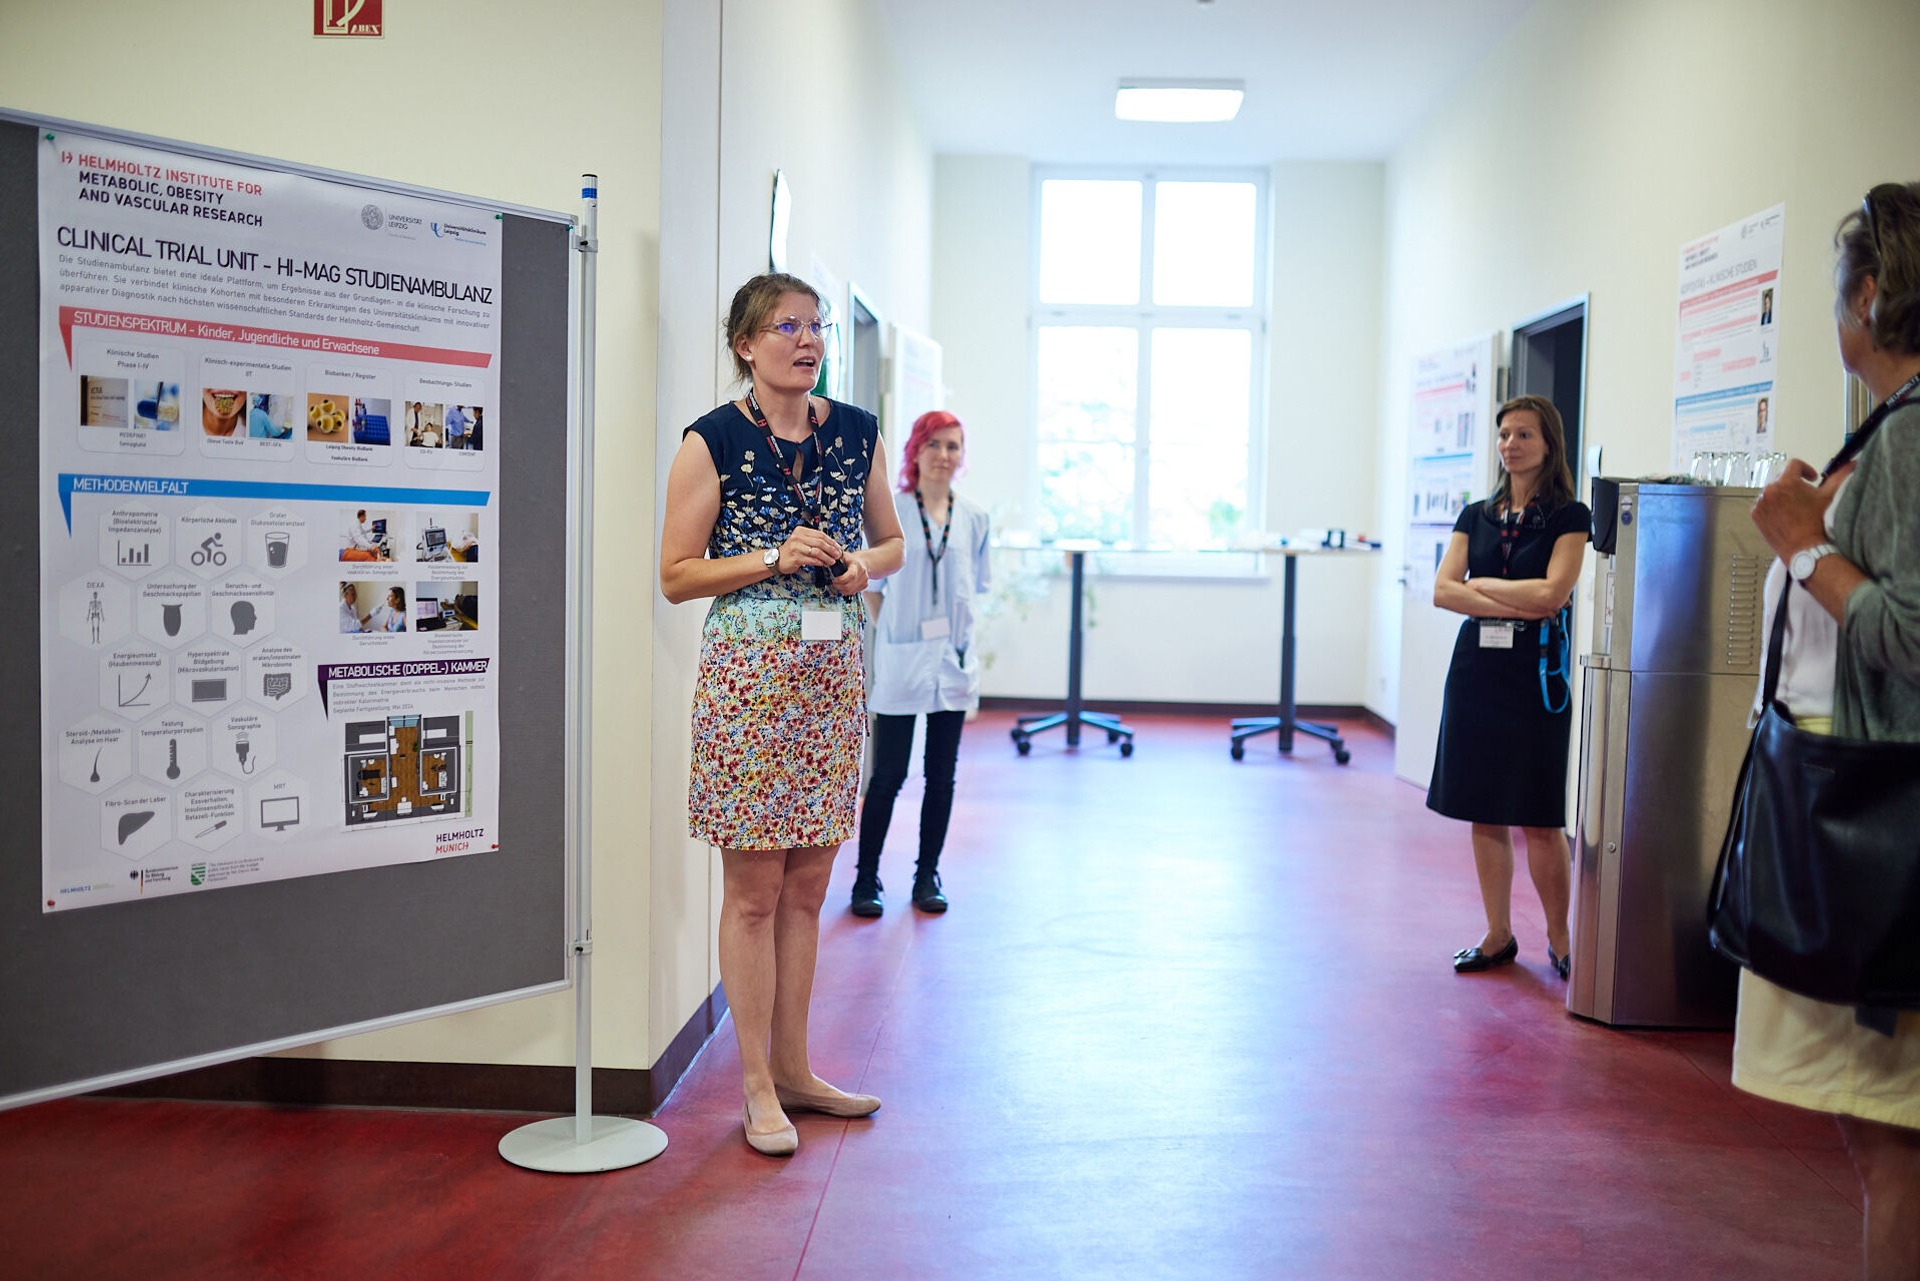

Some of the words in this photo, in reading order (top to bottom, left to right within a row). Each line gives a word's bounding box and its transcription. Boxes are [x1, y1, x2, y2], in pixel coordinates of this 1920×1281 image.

[79, 154, 160, 178] HELMHOLTZ
[166, 170, 233, 191] INSTITUTE
[237, 182, 262, 196] FOR
[80, 171, 163, 196] METABOLIC,
[167, 186, 223, 204] OBESITY
[79, 188, 109, 203] AND
[114, 193, 189, 216] VASCULAR
[194, 205, 262, 227] RESEARCH
[57, 226, 152, 258] CLINICAL
[156, 240, 212, 266] TRIAL
[217, 248, 258, 271] UNIT
[277, 257, 341, 283] HI-MAG
[345, 268, 492, 304] STUDIENAMBULANZ
[59, 254, 73, 263] Die
[78, 257, 150, 274] Studienambulanz
[154, 267, 176, 277] bietet
[180, 271, 196, 279] eine
[201, 273, 223, 283] ideale
[227, 276, 263, 289] Plattform,
[281, 283, 320, 295] Ergebnisse
[418, 302, 445, 312] klinische
[448, 306, 480, 318] Forschung
[60, 283, 109, 295] apparativer
[112, 288, 155, 300] Diagnostik
[158, 294, 176, 303] nach
[180, 297, 214, 307] höchsten
[217, 302, 286, 316] wissenschaftlichen
[289, 310, 324, 320] Standards
[114, 275, 126, 283] Sie
[131, 278, 168, 288] verbindet
[172, 281, 207, 293] klinische
[210, 287, 245, 298] Kohorten
[264, 295, 305, 306] besonderen
[308, 300, 356, 313] Erkrankungen
[74, 311, 186, 334] STUDIENSPEKTRUM
[198, 325, 235, 340] Kinder,
[238, 328, 298, 346] Jugendliche
[301, 336, 319, 348] und
[322, 337, 379, 355] Erwachsene
[107, 349, 135, 359] Klinische
[117, 360, 136, 369] Phase
[73, 477, 189, 495] METHODENVIELFALT
[181, 516, 213, 525] Körperliche
[113, 652, 157, 660] Energieumsatz
[187, 650, 230, 658] Hyperspektrale
[108, 659, 161, 667] (Haubenmessung)
[329, 664, 400, 678] METABOLISCHE
[403, 662, 449, 676] (DOPPEL-)
[451, 660, 487, 672] KAMMER
[71, 736, 95, 745] Analyse
[105, 798, 138, 808] Fibro-Scan
[436, 829, 484, 842] HELMHOLTZ
[436, 842, 469, 854] MUNICH
